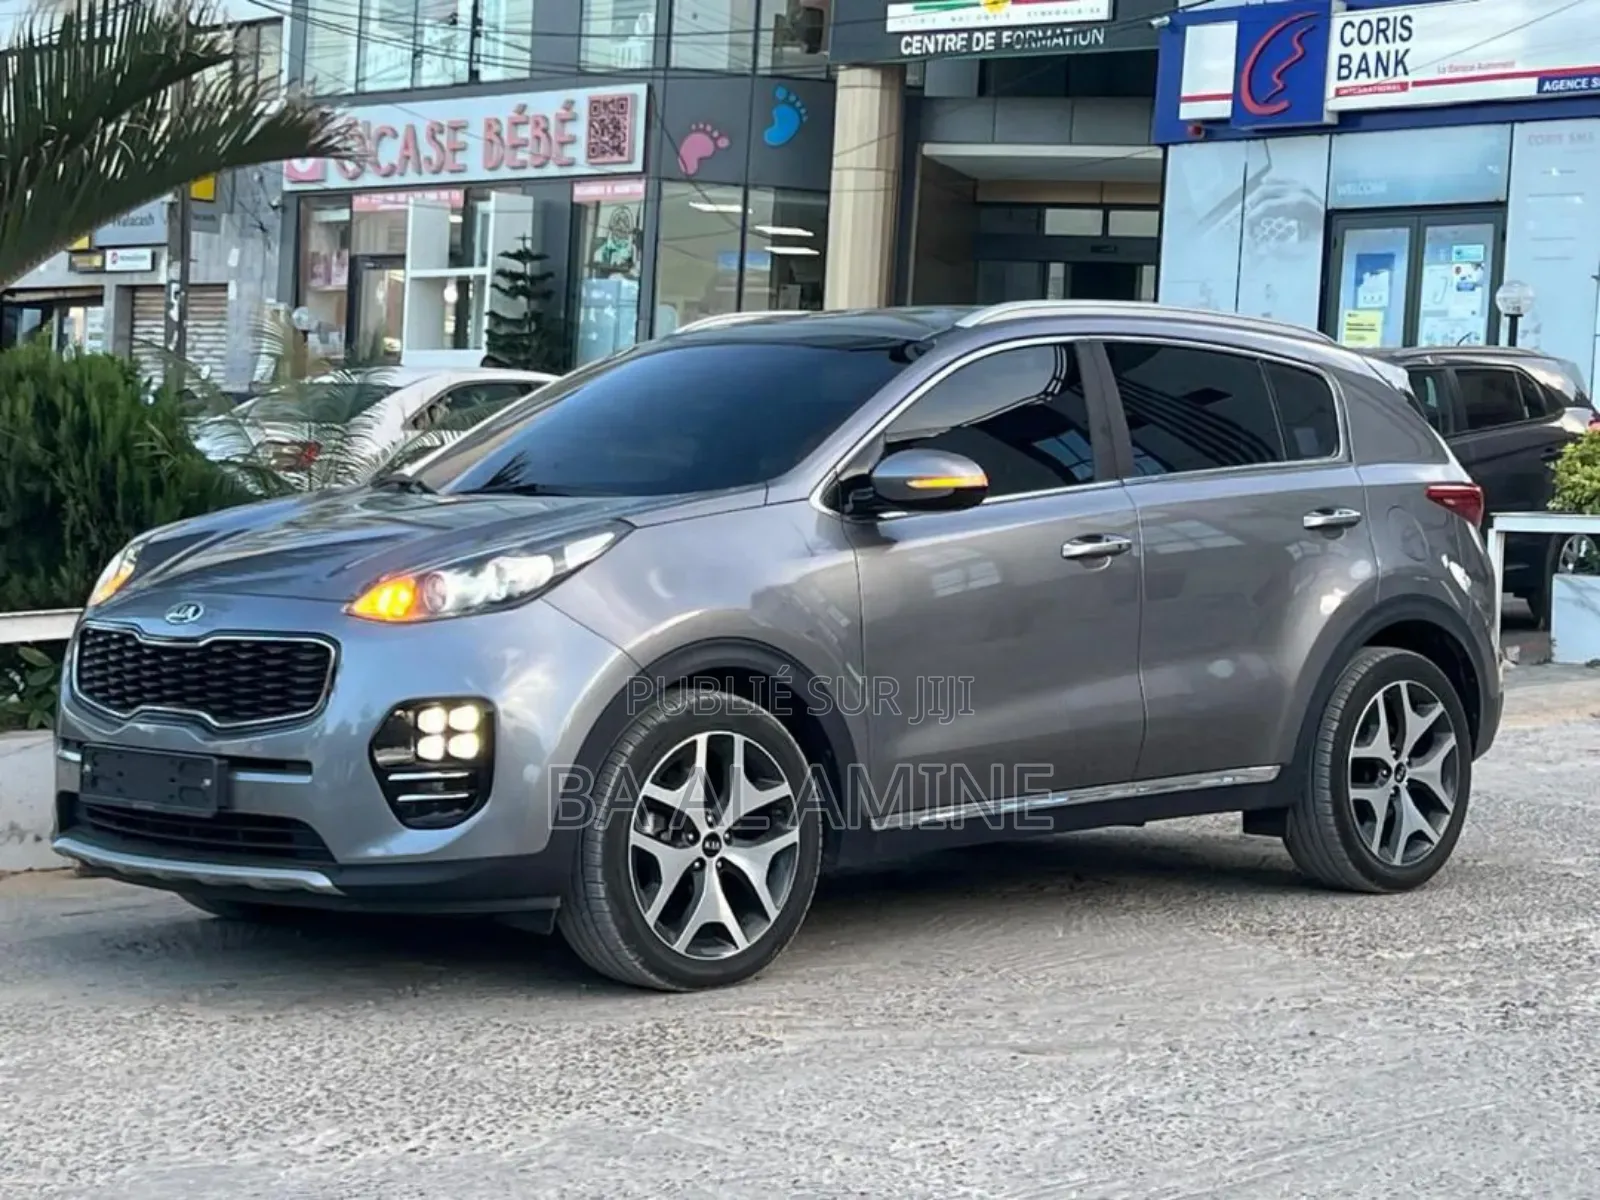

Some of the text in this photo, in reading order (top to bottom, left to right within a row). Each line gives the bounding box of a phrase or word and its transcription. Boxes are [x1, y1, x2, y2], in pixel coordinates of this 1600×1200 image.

[901, 27, 1104, 55] CENTRE DE FORMATION
[1340, 14, 1413, 48] CORIS
[1337, 48, 1410, 81] BANK
[1543, 78, 1589, 91] AGENCE
[483, 100, 578, 171] BÉBÉ
